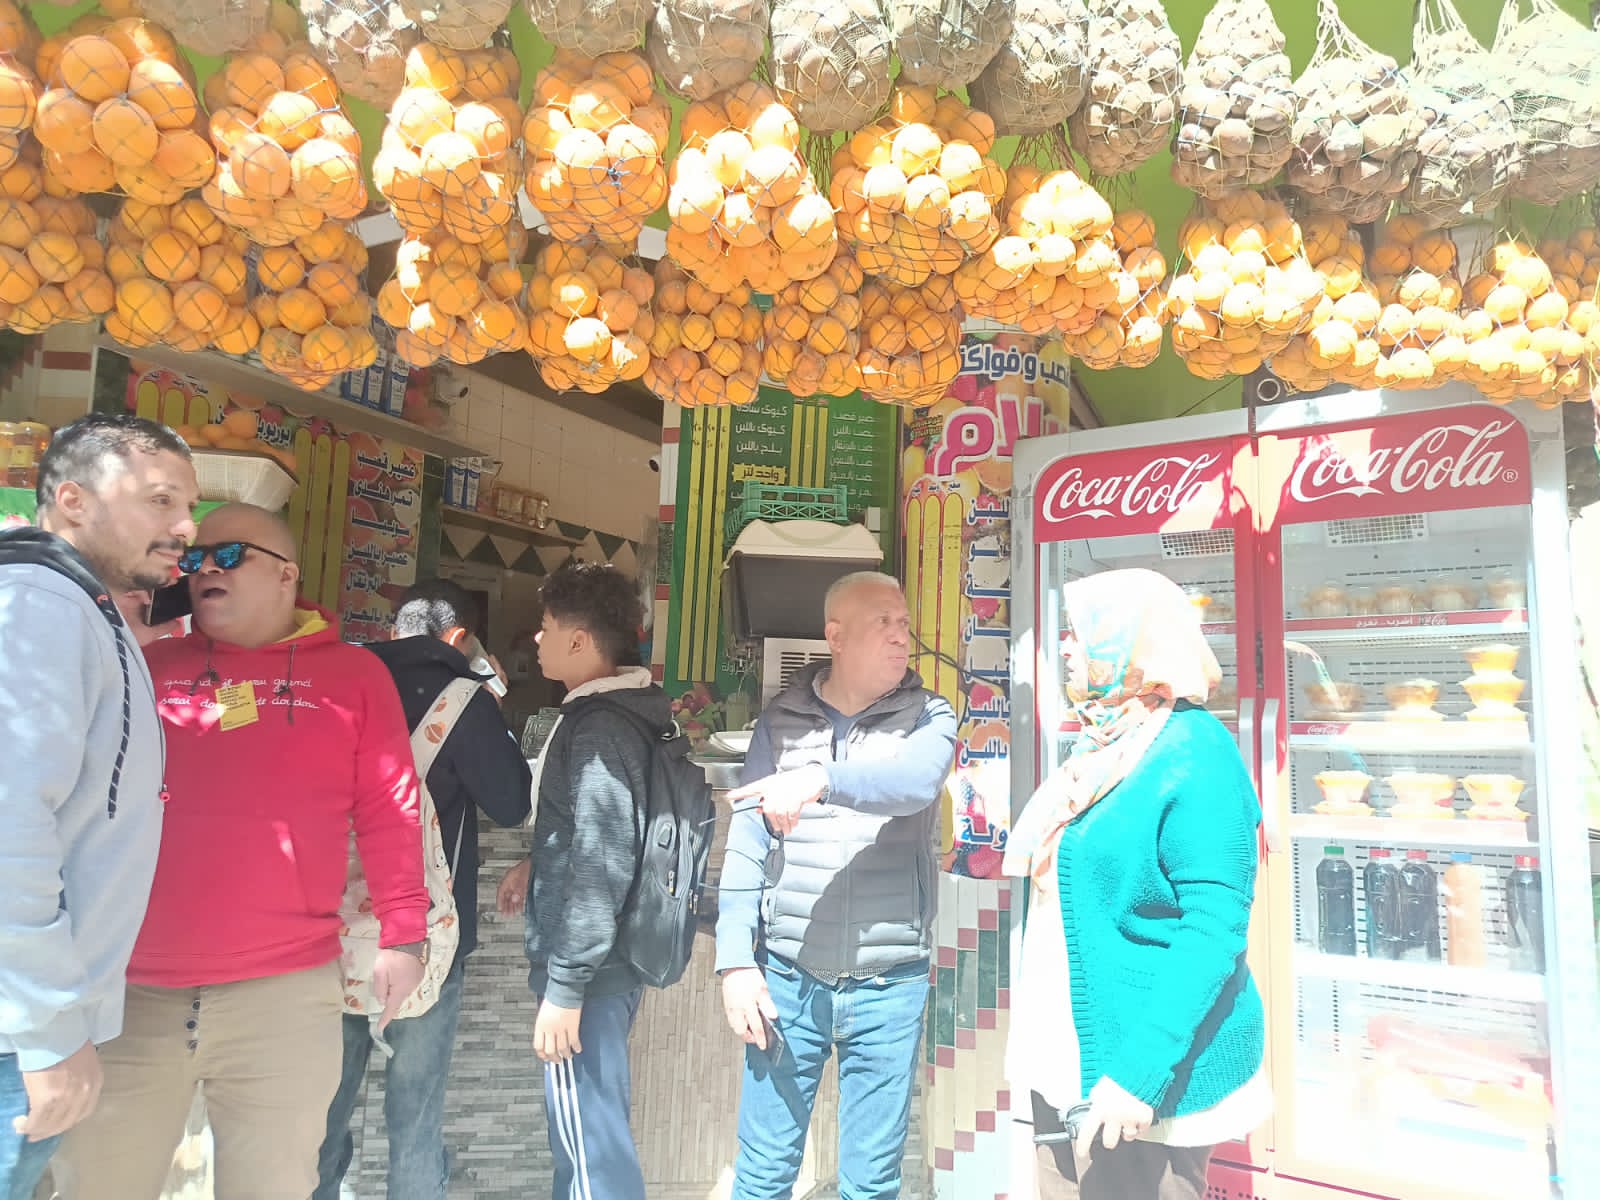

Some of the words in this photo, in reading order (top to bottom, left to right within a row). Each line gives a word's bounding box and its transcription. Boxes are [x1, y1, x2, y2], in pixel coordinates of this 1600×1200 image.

[1040, 361, 1068, 386] صب
[937, 398, 1066, 476] لام
[1290, 419, 1517, 503] Coca-Cola
[1042, 451, 1223, 523] Coca-Cola
[960, 817, 1008, 850] ولة
